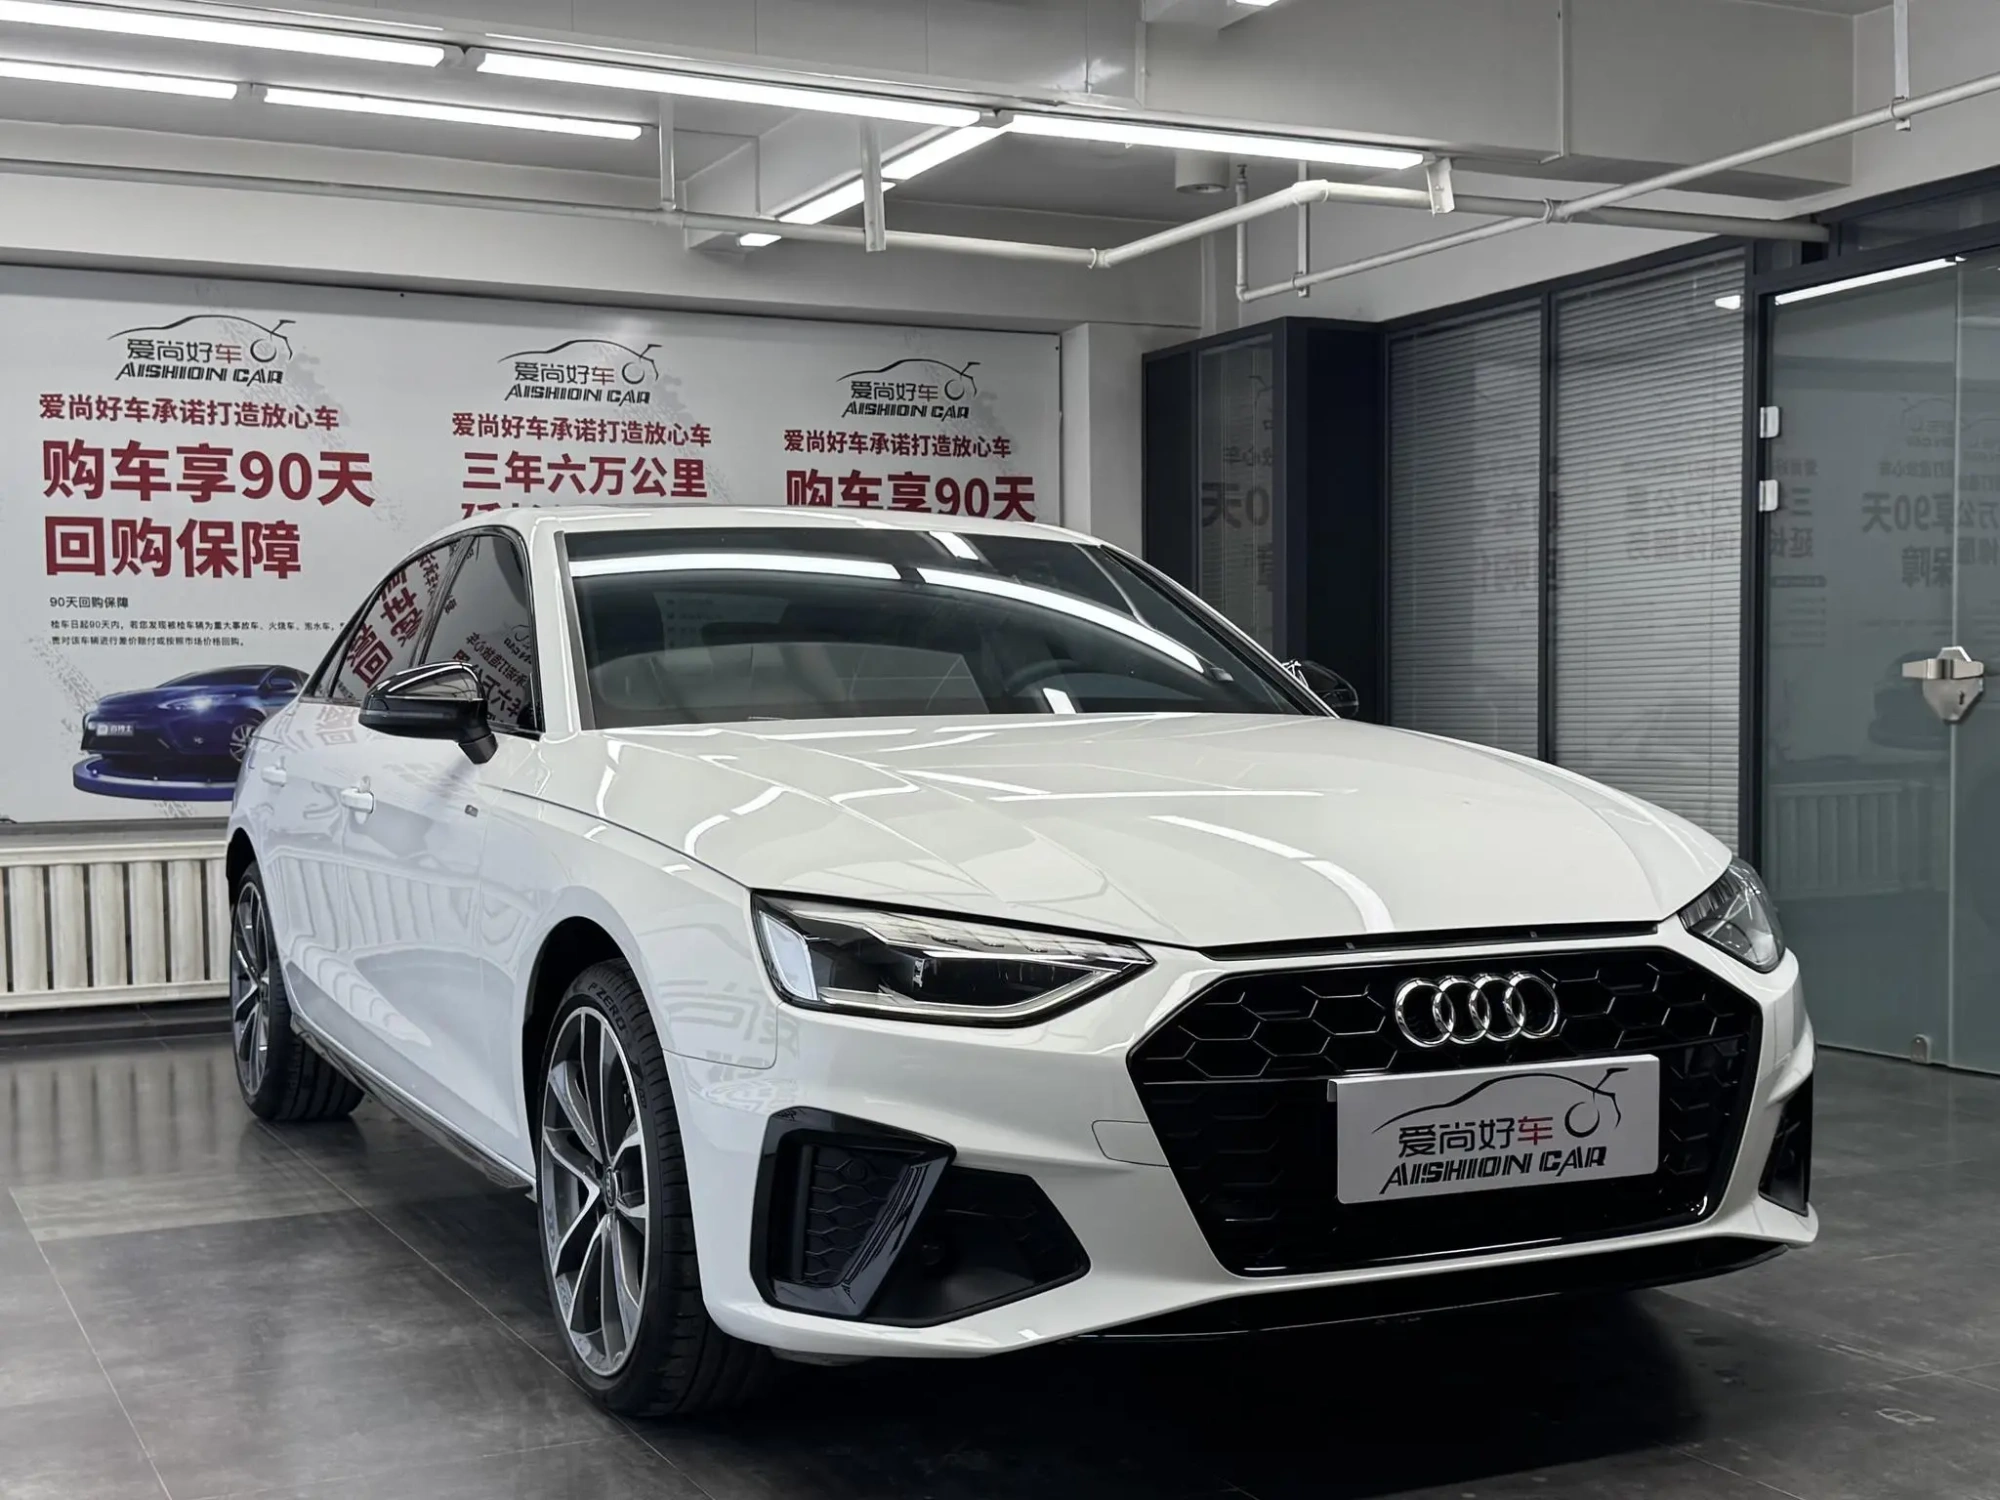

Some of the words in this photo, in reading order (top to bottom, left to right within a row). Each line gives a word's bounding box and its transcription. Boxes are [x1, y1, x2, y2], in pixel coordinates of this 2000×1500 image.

[127, 338, 242, 364] 爱尚好车
[115, 362, 228, 382] AISHION
[232, 367, 284, 387] CAR
[514, 361, 615, 386] 爱尚好车
[504, 383, 602, 401] AISHION
[606, 389, 651, 407] CAR
[850, 380, 938, 402] 爱尚好车
[39, 393, 340, 431] 爱尚好车承诺打造放心车
[841, 401, 927, 418] AISHION
[931, 405, 970, 422] CAR
[452, 412, 712, 447] 爱尚好车承诺打造放心车
[784, 428, 1012, 458] 爱尚好车承诺打造放心车
[43, 438, 376, 508] 购车享90天
[463, 450, 708, 498] 三年六万公里
[786, 469, 1037, 522] 购车享90天
[45, 516, 302, 580] 回购保障
[49, 596, 129, 609] 90天回购保障
[1399, 1116, 1553, 1158] 爱尚好车
[1379, 1152, 1534, 1194] AISHION
[1538, 1146, 1607, 1177] CAR
